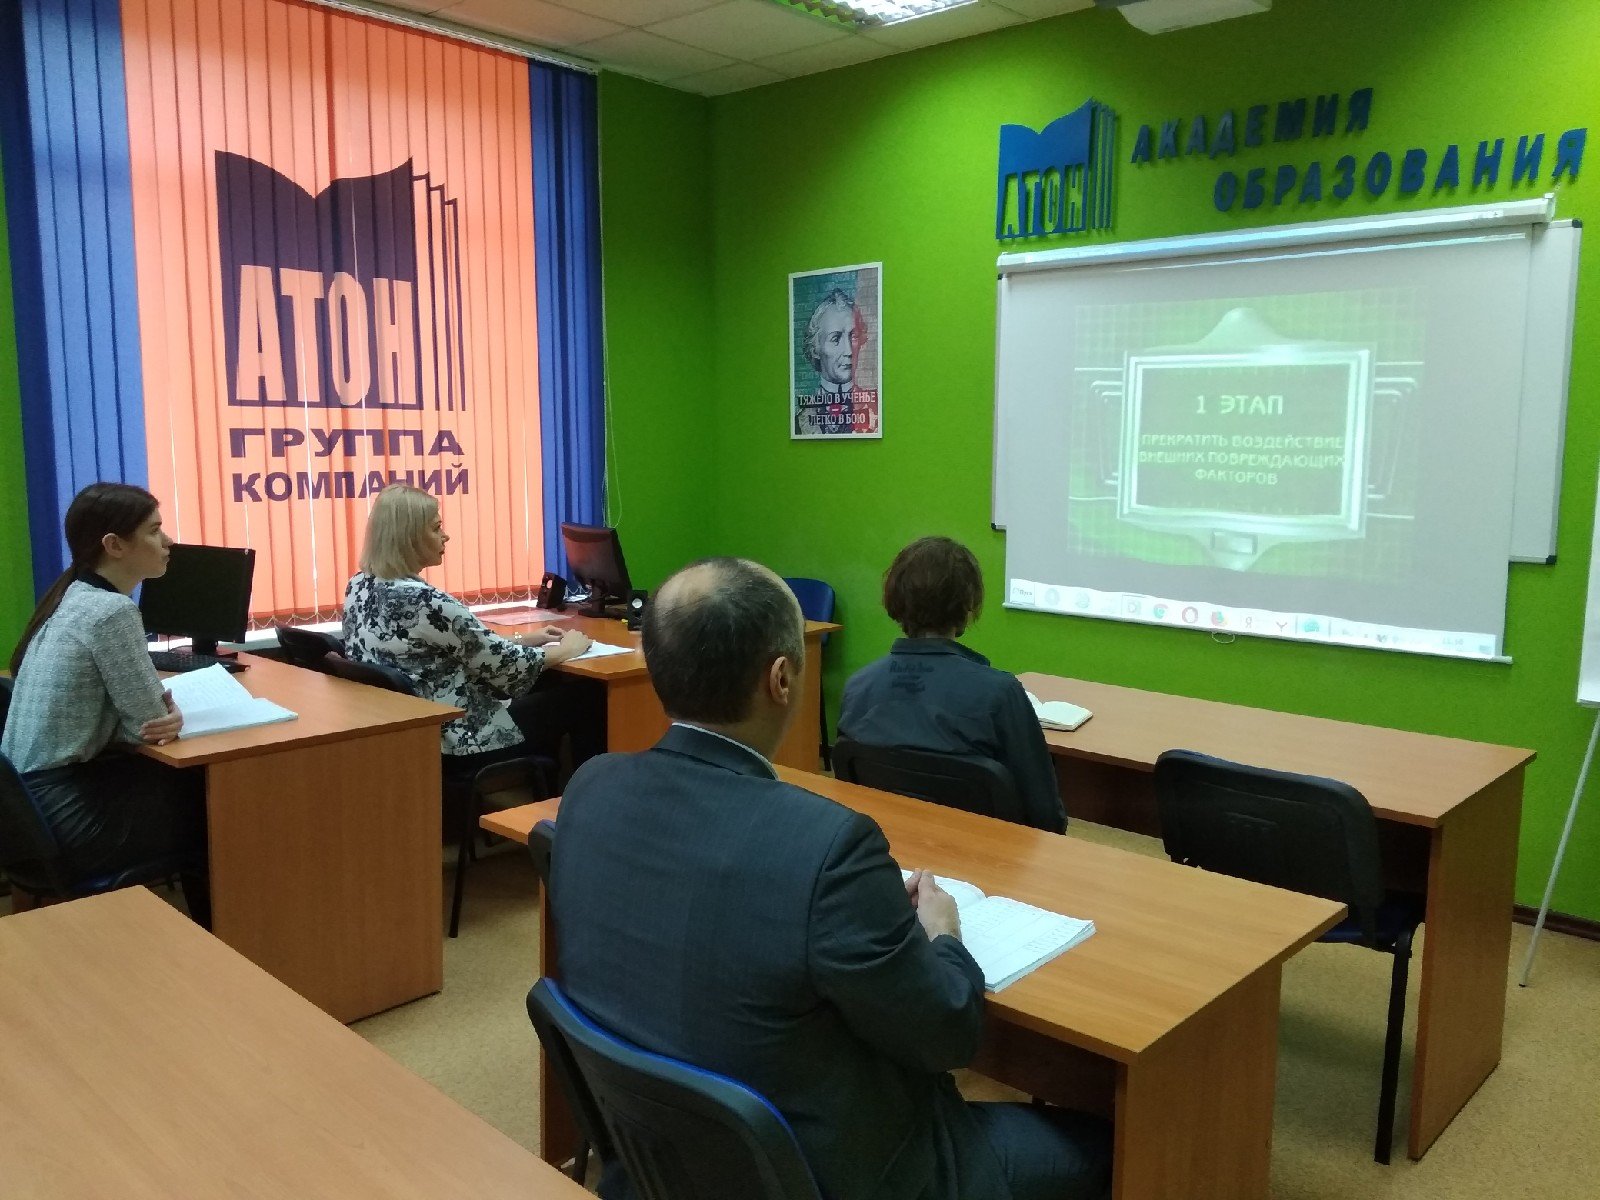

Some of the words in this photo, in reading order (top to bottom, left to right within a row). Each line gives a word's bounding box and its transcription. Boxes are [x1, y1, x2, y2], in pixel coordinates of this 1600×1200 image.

[1130, 87, 1374, 164] АКАДЕМИЯ
[1213, 127, 1588, 212] ОБРАЗОВАНИЯ
[1001, 162, 1086, 236] АТОН
[236, 264, 417, 406] АТОН
[799, 394, 832, 406] ТЯЖЕЛО
[834, 393, 841, 404] В
[842, 391, 876, 404] УЧЕНЬЕ
[1196, 395, 1206, 415] 1
[1219, 394, 1284, 415] ЭТАП
[810, 414, 837, 426] ЛЕГКО
[838, 414, 845, 425] В
[846, 412, 866, 425] БОЮ
[229, 427, 466, 458] ГРУППА
[1141, 434, 1229, 447] ПРЕКРАТИТЬ
[1231, 434, 1345, 449] ВОЗДЕЙСТВИЕ
[1194, 468, 1279, 486] ФАКТОРОВ
